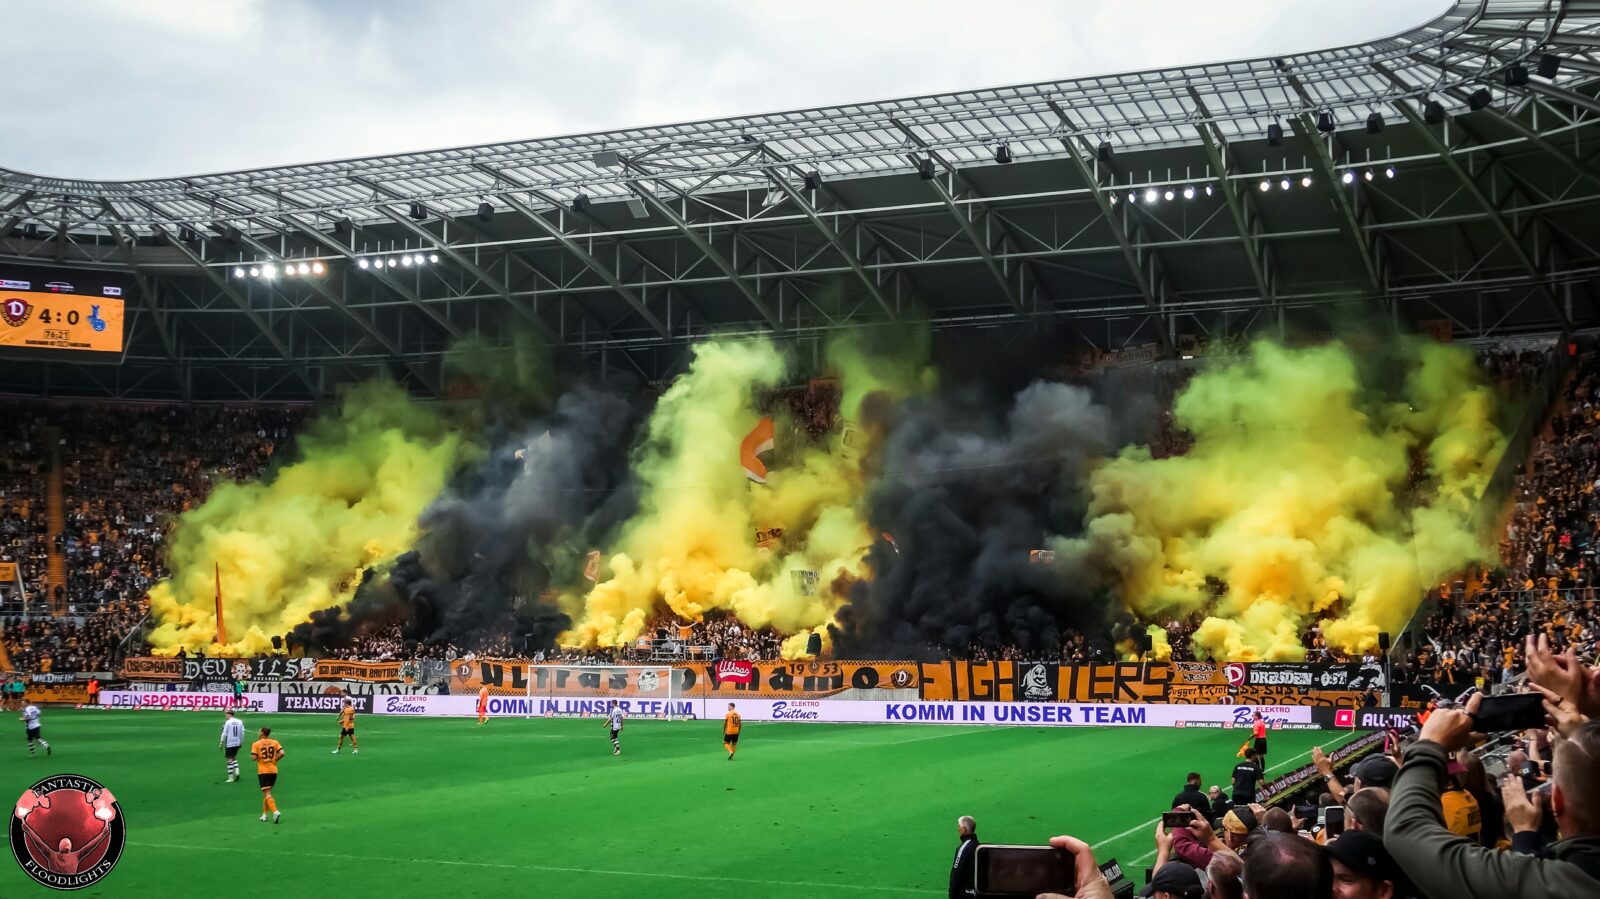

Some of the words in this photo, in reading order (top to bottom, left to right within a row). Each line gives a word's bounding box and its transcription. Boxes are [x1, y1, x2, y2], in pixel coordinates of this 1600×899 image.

[789, 664, 804, 674] 19
[823, 663, 838, 674] 53
[539, 699, 559, 713] IN
[637, 701, 693, 715] TEAM
[771, 701, 819, 720] Büttner
[886, 704, 954, 720] KOMM
[962, 705, 985, 721] IN
[994, 706, 1072, 722] UNSER
[1080, 707, 1146, 723] TEAM
[261, 746, 275, 759] 39
